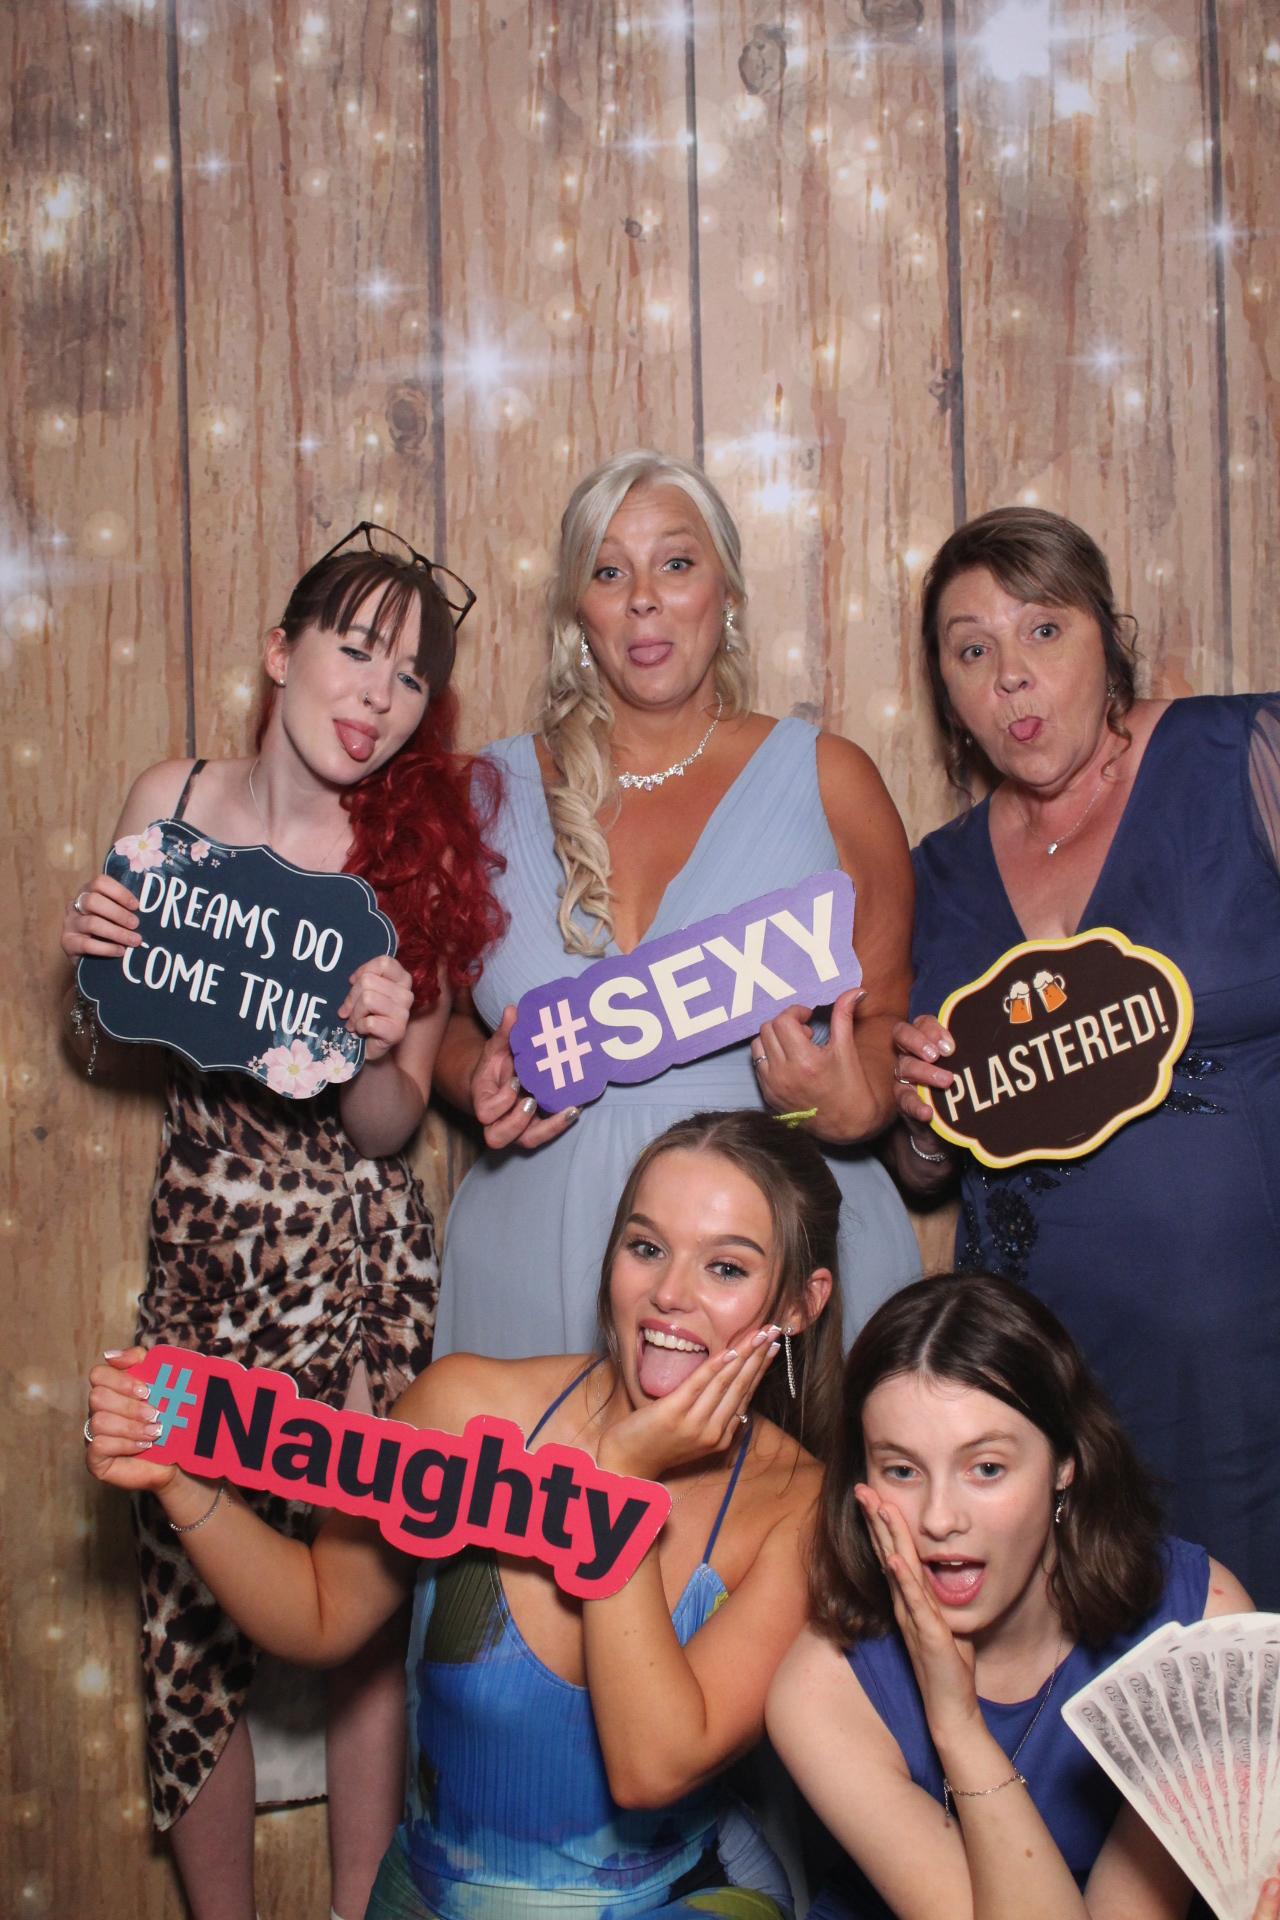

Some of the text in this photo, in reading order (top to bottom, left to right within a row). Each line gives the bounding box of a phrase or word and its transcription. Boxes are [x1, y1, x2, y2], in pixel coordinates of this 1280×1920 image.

[122, 941, 328, 1038] COME TRUE
[138, 872, 343, 972] DREAMS DO
[531, 890, 840, 1091] #SEXY
[944, 987, 1170, 1122] PLASTERED!
[146, 1363, 651, 1581] #Naughty
